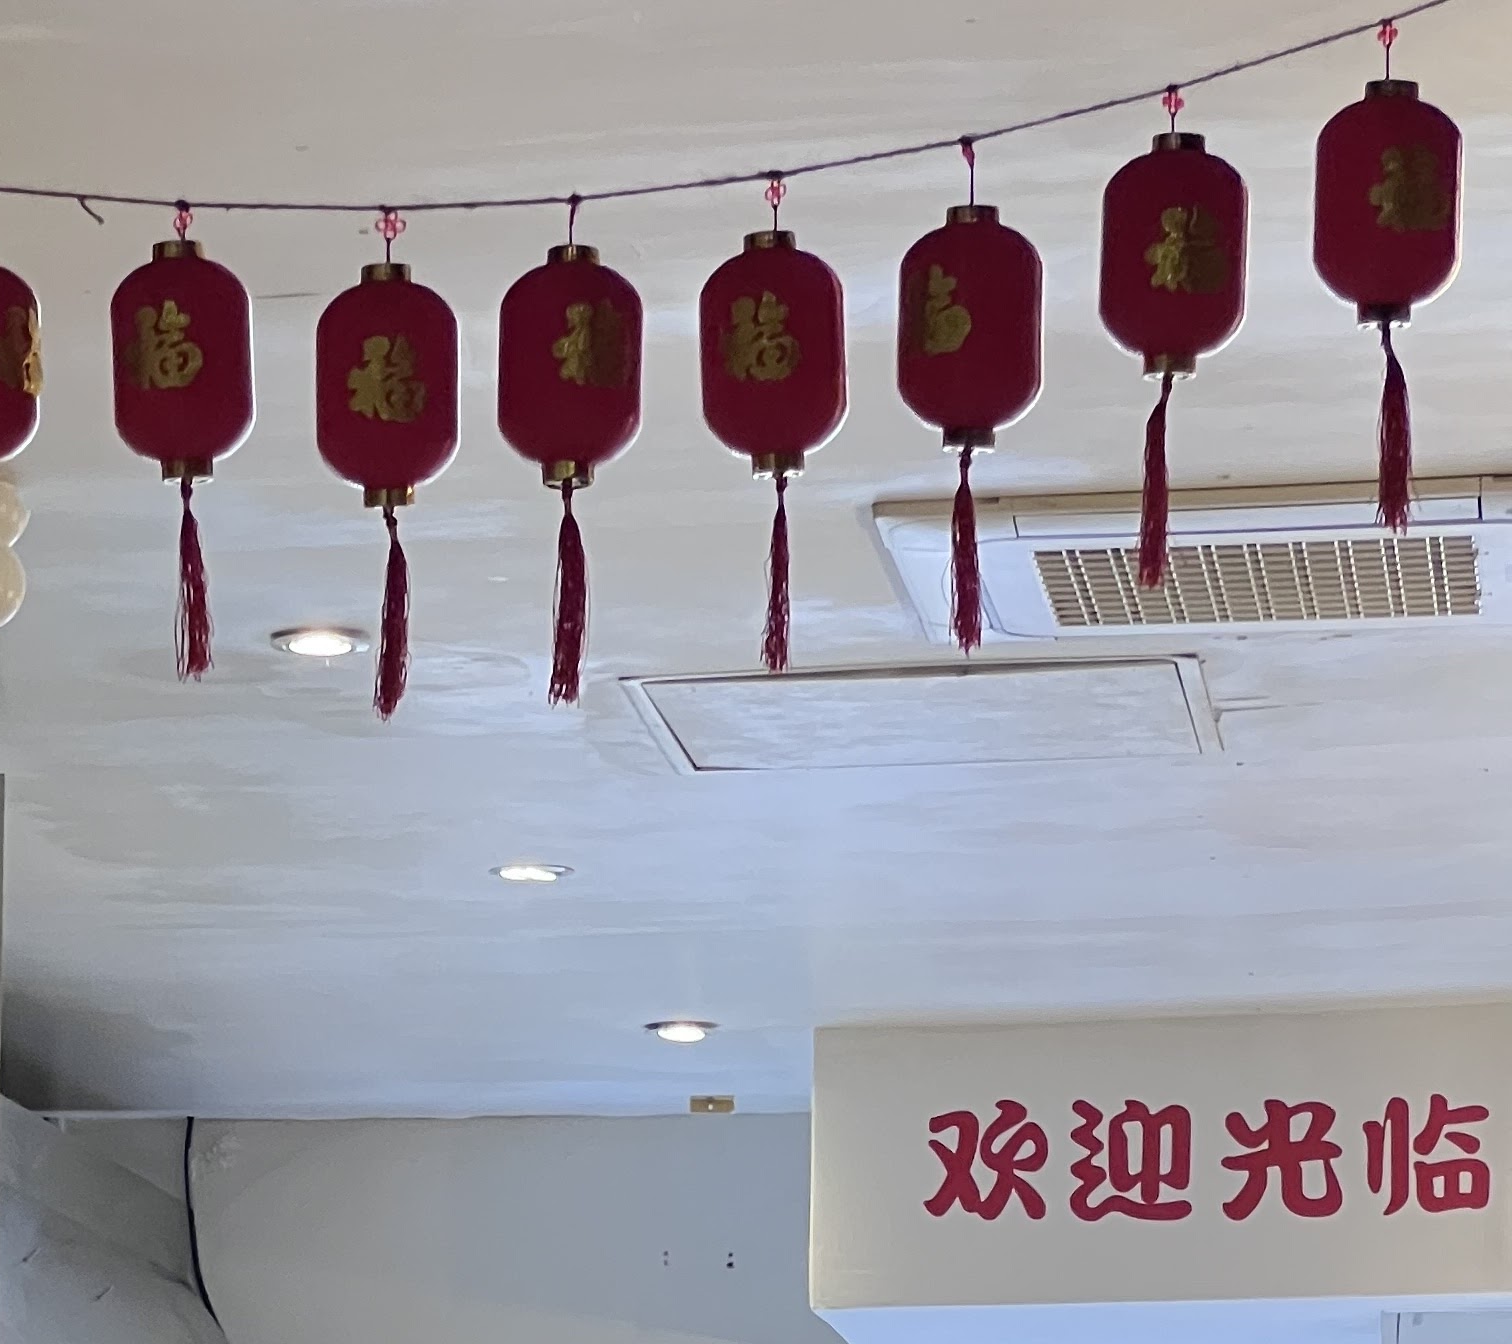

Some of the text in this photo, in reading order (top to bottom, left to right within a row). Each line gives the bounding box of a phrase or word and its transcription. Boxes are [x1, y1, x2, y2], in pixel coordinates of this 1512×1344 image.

[125, 299, 203, 390] 福
[346, 334, 425, 423] 福
[723, 290, 799, 382] 福
[924, 1094, 1490, 1221] 欢迎光临
